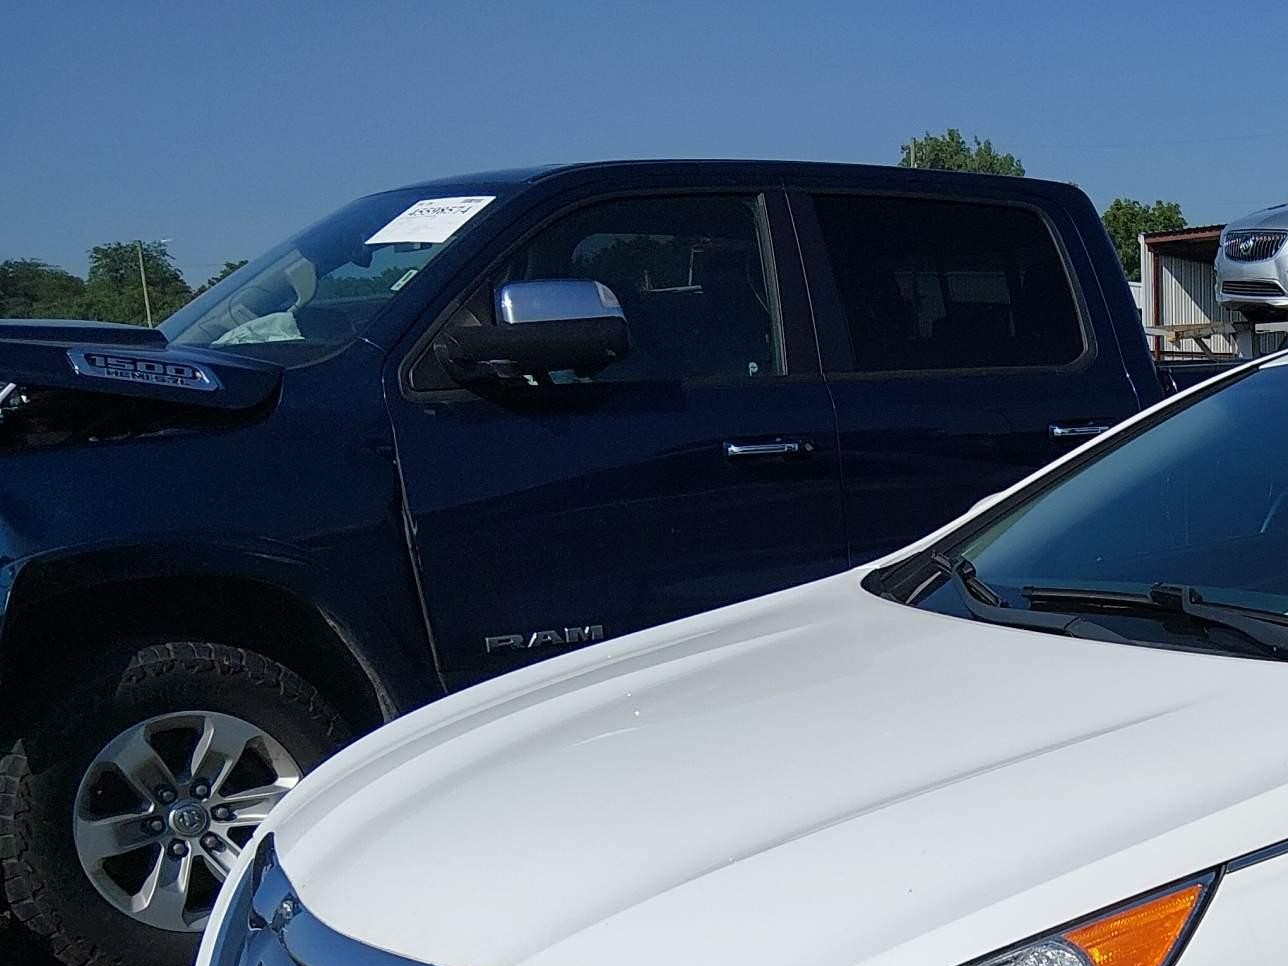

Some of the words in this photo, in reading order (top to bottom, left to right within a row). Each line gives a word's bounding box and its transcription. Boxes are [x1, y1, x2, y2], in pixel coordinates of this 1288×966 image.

[86, 355, 193, 378] 1500
[105, 367, 151, 381] HEMI
[485, 625, 604, 653] RAM
